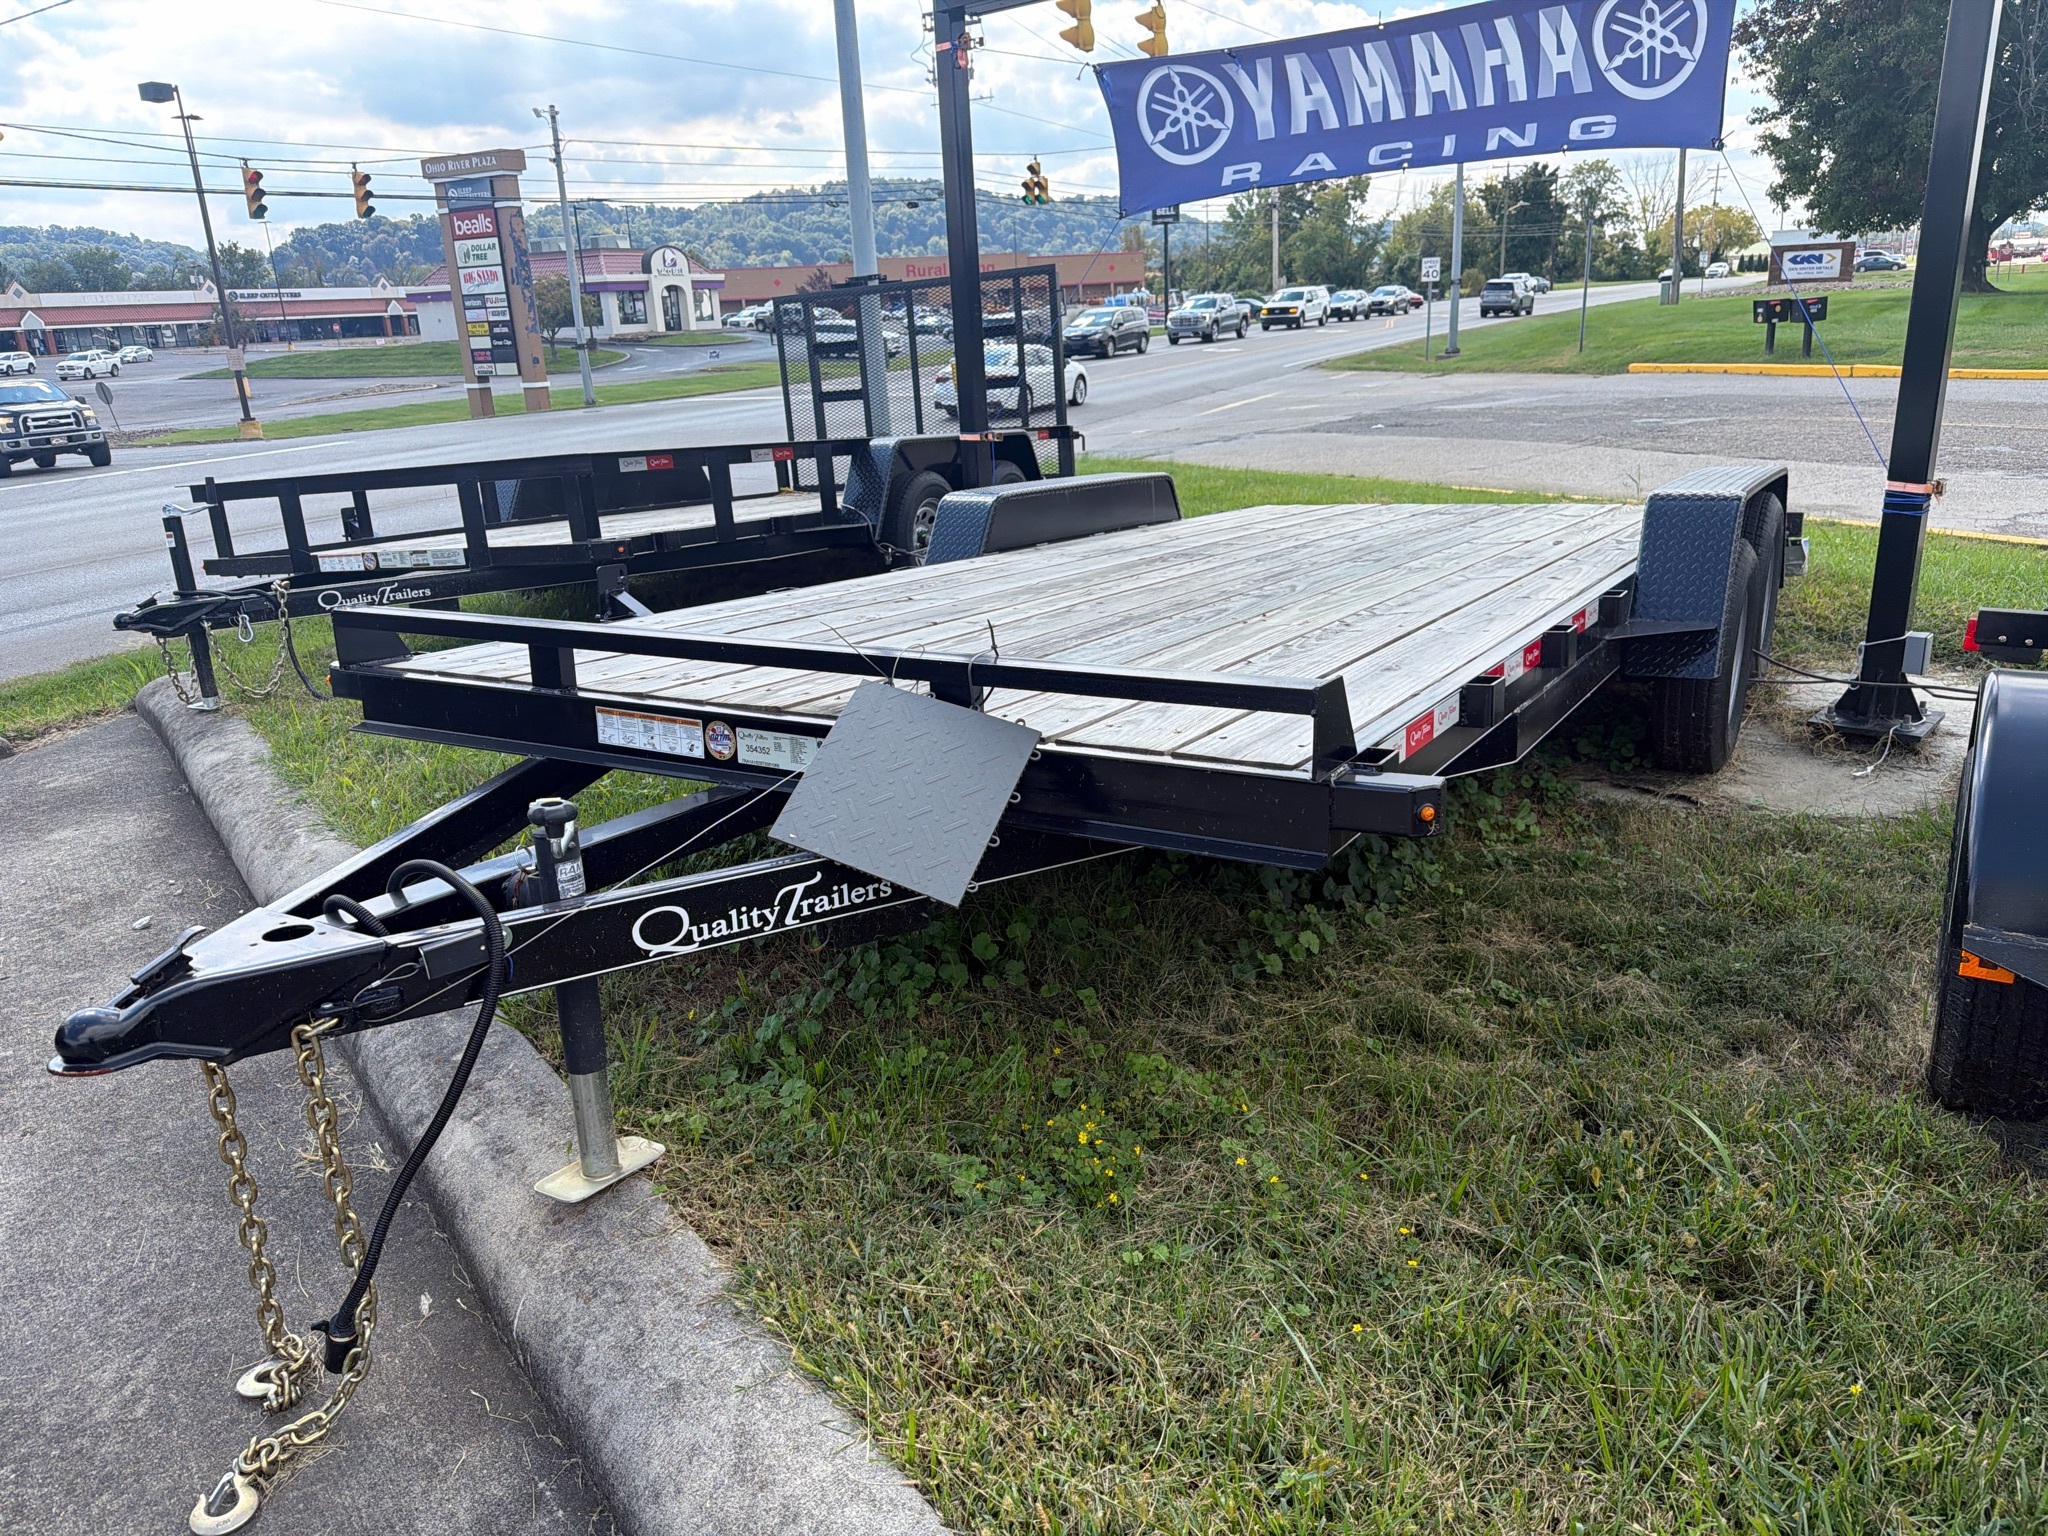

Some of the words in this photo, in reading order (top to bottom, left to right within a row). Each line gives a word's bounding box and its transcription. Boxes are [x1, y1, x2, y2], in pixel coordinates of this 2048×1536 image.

[1221, 6, 1593, 140] YAMAHA
[1221, 115, 1617, 187] RACING
[425, 163, 446, 174] OHIO
[447, 159, 470, 171] RIVER
[472, 156, 497, 168] PLAZA
[453, 213, 493, 236] bealls
[471, 242, 497, 252] DOLLAR
[471, 252, 488, 261] TREE
[1787, 253, 1824, 265] GKN
[463, 271, 476, 284] BIG
[905, 262, 947, 278] Rural
[1422, 269, 1439, 279] 40
[317, 590, 381, 610] Quality
[377, 582, 432, 604] Trailers
[745, 744, 771, 755] 354352
[632, 905, 780, 958] Quality
[775, 871, 893, 926] Trailers
